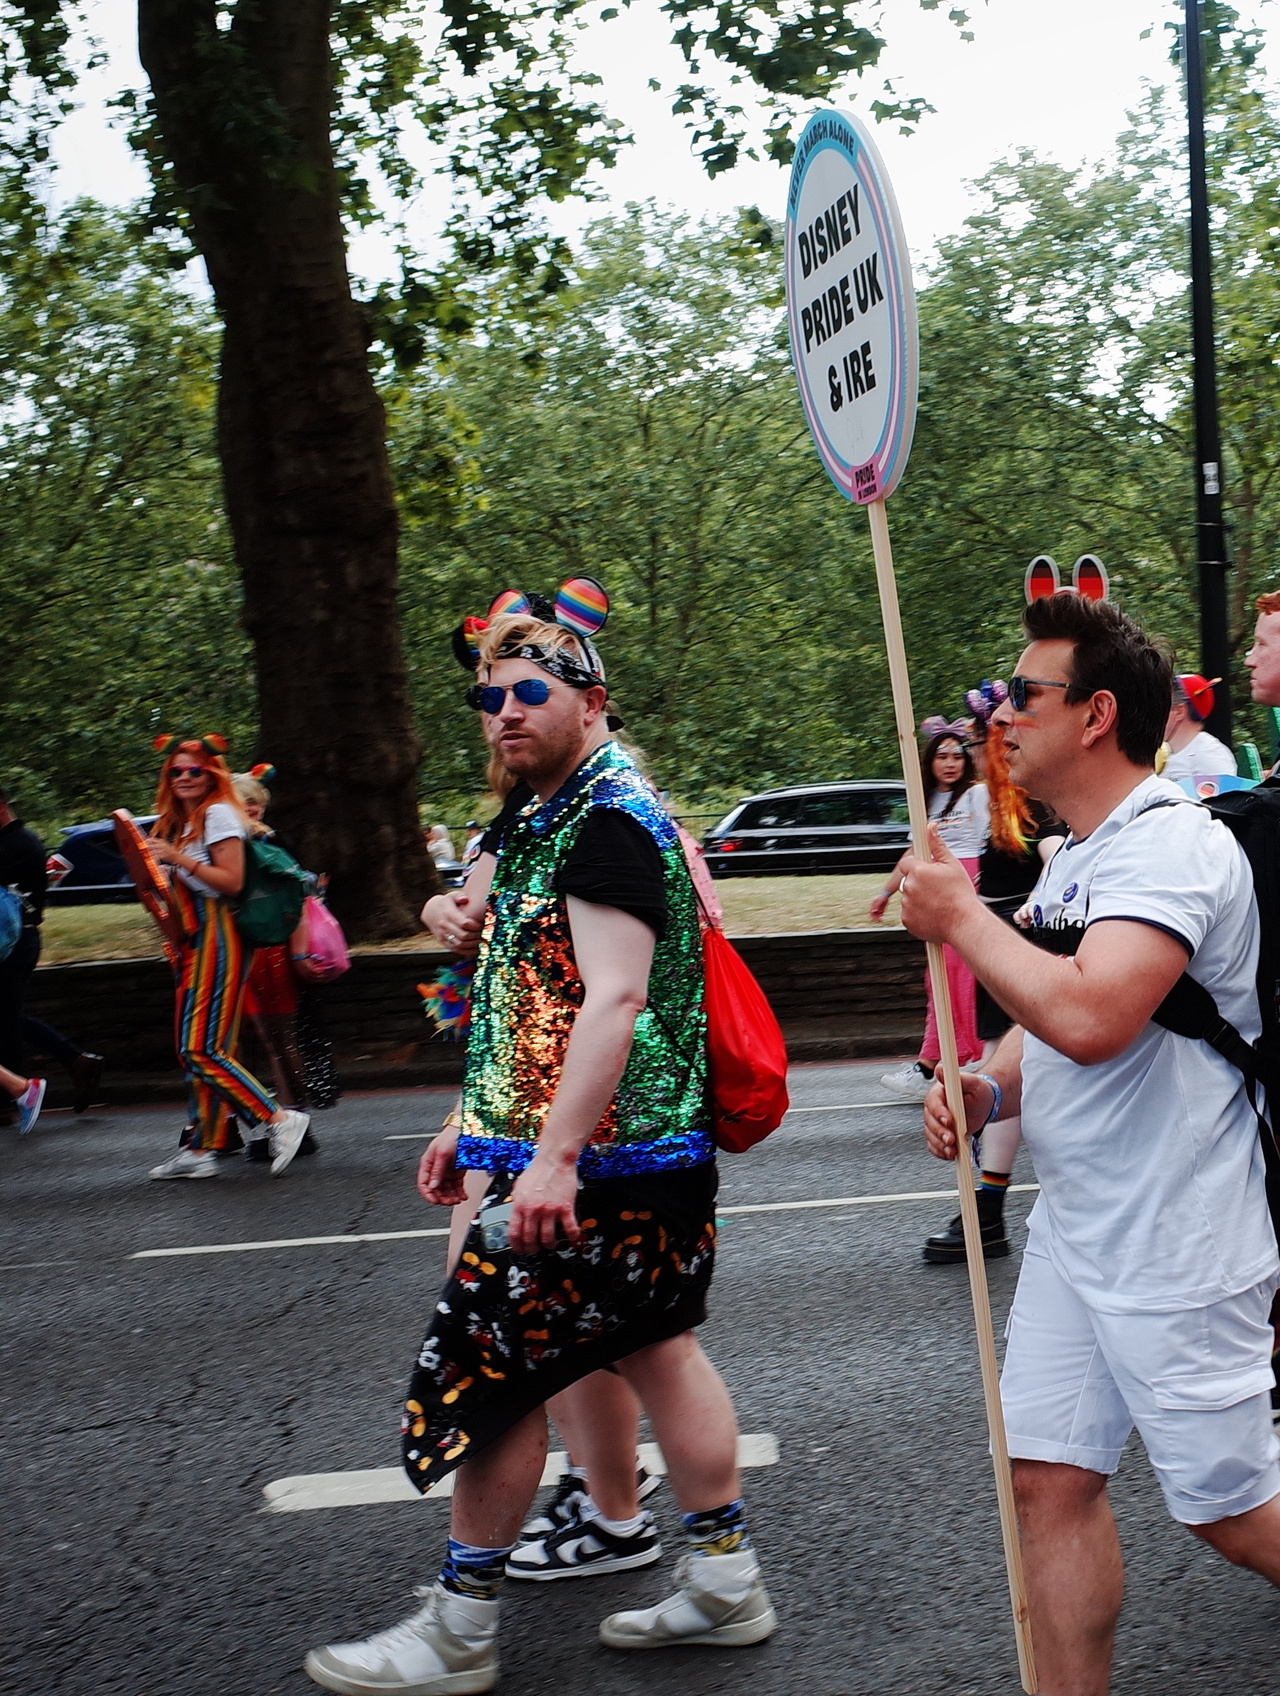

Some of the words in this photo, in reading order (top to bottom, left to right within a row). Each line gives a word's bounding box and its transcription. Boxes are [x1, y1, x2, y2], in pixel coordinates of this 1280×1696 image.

[803, 119, 828, 158] MARCH
[828, 119, 855, 157] ALONE
[798, 183, 861, 280] DISNEY
[801, 274, 855, 354] PRIDE
[853, 251, 885, 315] UK
[828, 365, 843, 412] &
[842, 340, 877, 403] IRE
[855, 463, 875, 488] PRIDE
